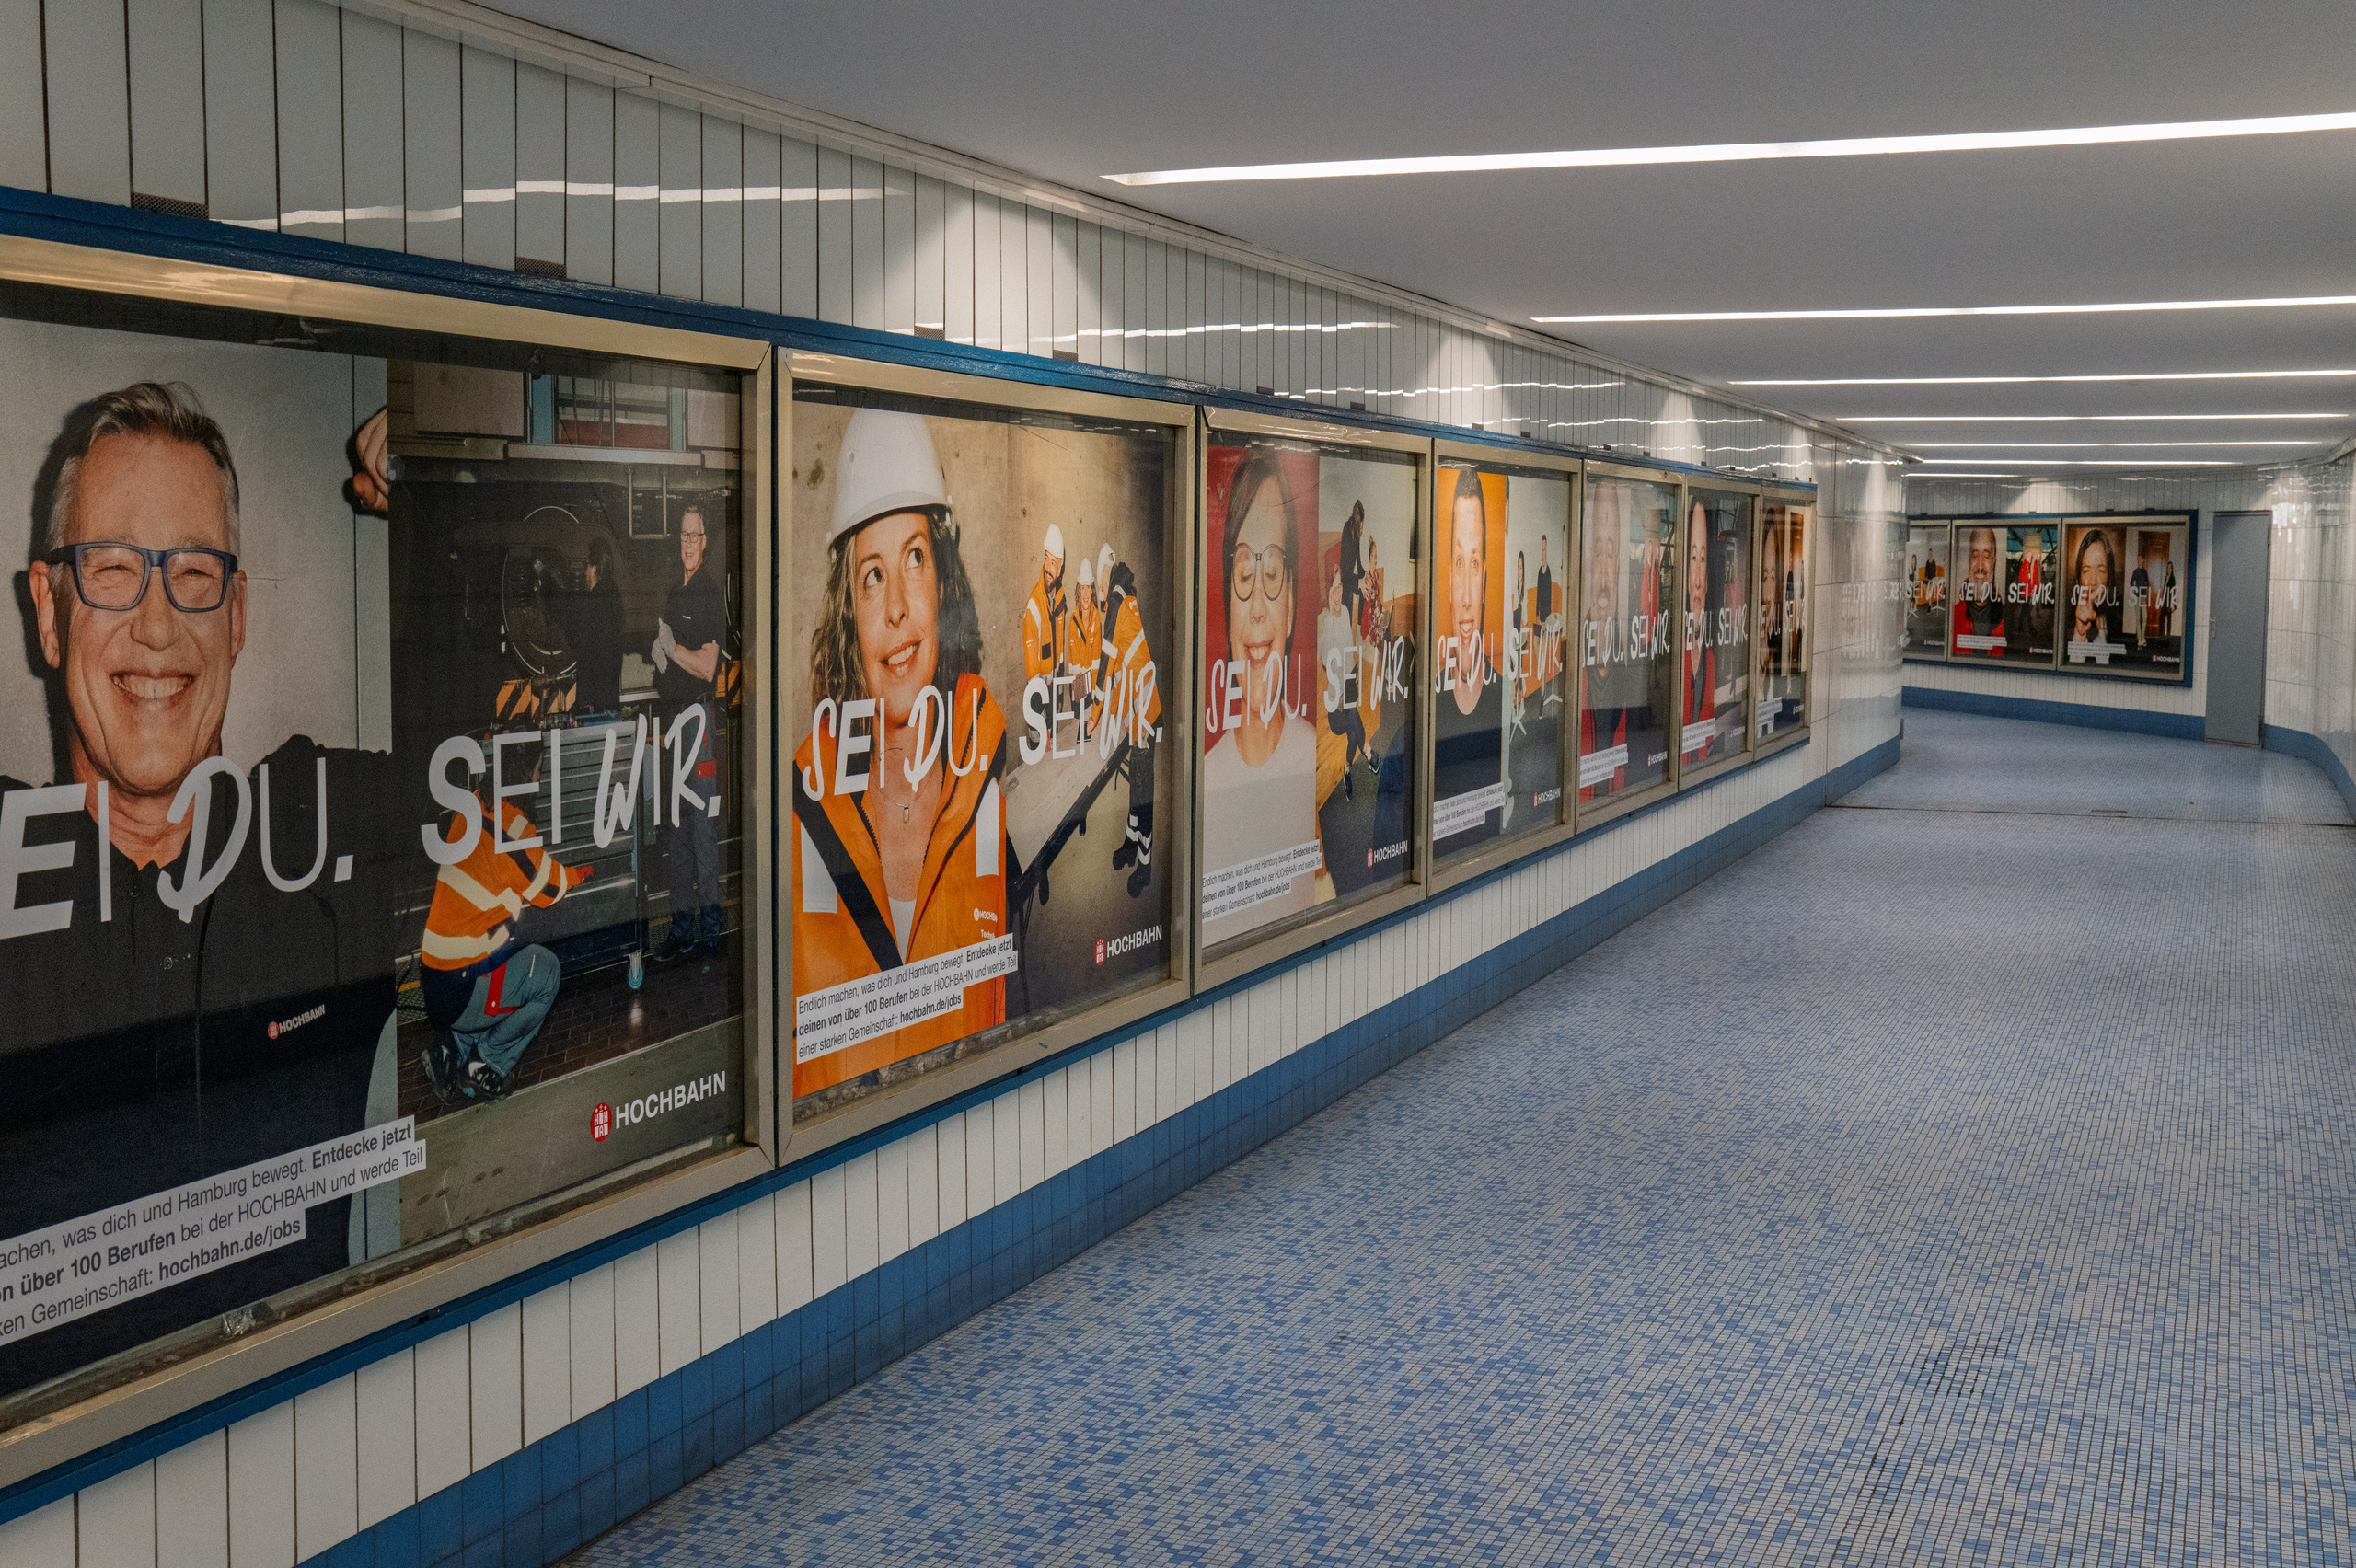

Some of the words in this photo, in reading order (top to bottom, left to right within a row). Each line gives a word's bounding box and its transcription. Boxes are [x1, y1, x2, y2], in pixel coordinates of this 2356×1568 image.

[1959, 582, 1977, 601] SEI
[1980, 582, 2001, 603] DU.
[2008, 582, 2028, 604] SEI
[2032, 582, 2055, 605] WIR.
[2071, 583, 2091, 605] SEI
[2094, 584, 2119, 607] DU.
[2128, 585, 2151, 607] SEI
[1436, 634, 1461, 694] SEI
[1467, 629, 1496, 692] DU.
[1508, 628, 1532, 681] SEI
[1602, 616, 1623, 668] DU.
[1631, 615, 1648, 660] SEI
[1651, 609, 1669, 660] WIR.
[1698, 608, 1713, 652] DU.
[1718, 607, 1731, 646] SEI
[1206, 658, 1251, 733] SEI
[1259, 650, 1308, 731] DU.
[1323, 645, 1363, 713] SEI
[1369, 635, 1409, 711] WIR.
[803, 698, 885, 801] SEI
[903, 684, 989, 793] DU.
[1019, 675, 1085, 765] SEI
[1099, 660, 1163, 760] WIR.
[157, 755, 353, 923] DU.
[421, 728, 562, 865] SEI
[593, 703, 722, 848] WIR.
[1374, 840, 1408, 863] HOCHBAHN
[1106, 924, 1162, 958] HOCHBAHN
[799, 995, 826, 1014] Endlich
[828, 986, 859, 1005] machen,
[861, 982, 875, 995] was
[877, 974, 892, 990] dich
[894, 969, 907, 985] und
[908, 963, 939, 980] Hamburg
[940, 953, 965, 971] bewegt.
[966, 943, 997, 963] Entdecke
[998, 938, 1011, 956] jetzt
[799, 1018, 826, 1036] deinen
[828, 1013, 842, 1026] von
[845, 1007, 862, 1020] über
[865, 999, 877, 1015] 100
[879, 992, 907, 1010] Berufen
[909, 985, 920, 1000] bei
[921, 982, 932, 996] der
[934, 969, 973, 992] HOCHBAHN
[975, 966, 986, 979] und
[987, 960, 1005, 974] werde
[1007, 954, 1017, 968] Teil
[279, 1004, 326, 1034] HOCHBAHN
[798, 1042, 818, 1058] einer
[819, 1033, 847, 1051] starken
[849, 1013, 898, 1041] Gemeinschaft:
[900, 993, 962, 1024] hochbahn.de/jobs
[615, 1070, 726, 1130] HOCHBAHN
[63, 1225, 96, 1249] was
[102, 1209, 136, 1236] dich
[143, 1196, 172, 1222] und
[178, 1176, 247, 1212] Hamburg
[252, 1156, 306, 1188] bewegt.
[312, 1136, 378, 1170] Entdecke
[381, 1124, 411, 1151] jetzt
[20, 1266, 64, 1295] über
[71, 1251, 101, 1278] 100
[108, 1231, 176, 1266] Berufen
[181, 1216, 203, 1242] bei
[209, 1209, 234, 1233] der
[238, 1177, 327, 1223] HOCHBAHN
[331, 1168, 356, 1192] und
[360, 1157, 399, 1182] werde
[402, 1146, 423, 1169] Teil
[32, 1267, 153, 1324] Gemeinschaft:
[158, 1218, 301, 1280] hochbahn.de/jobs
